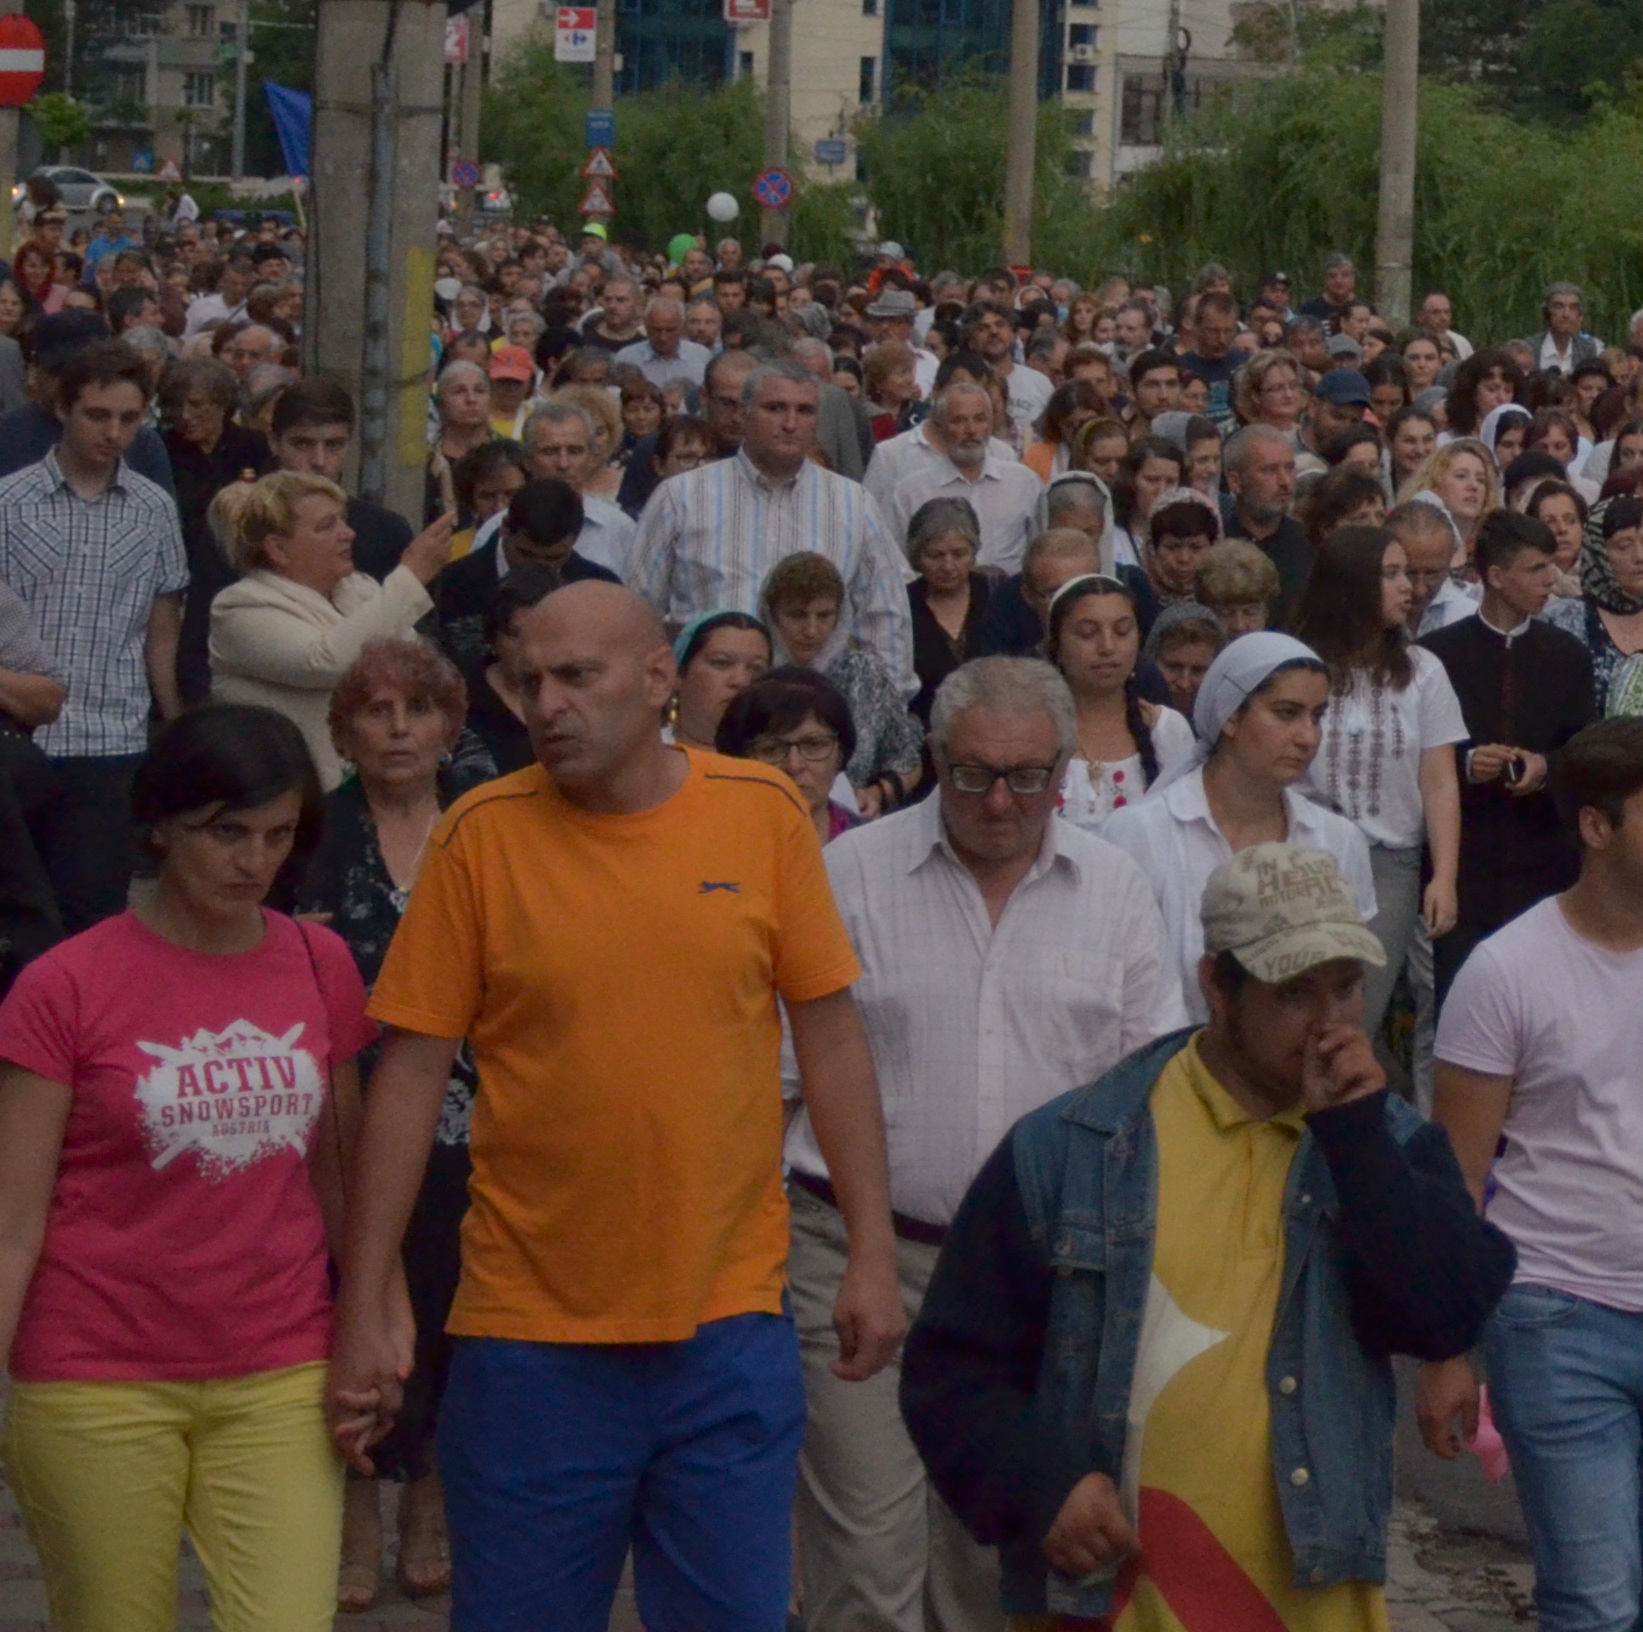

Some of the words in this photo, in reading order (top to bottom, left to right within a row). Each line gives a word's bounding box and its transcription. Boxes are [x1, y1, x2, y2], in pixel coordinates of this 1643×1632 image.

[176, 1056, 297, 1099] ACTIV
[161, 1093, 314, 1128] SNOWSPORT
[212, 1120, 270, 1138] AUSTRIA
